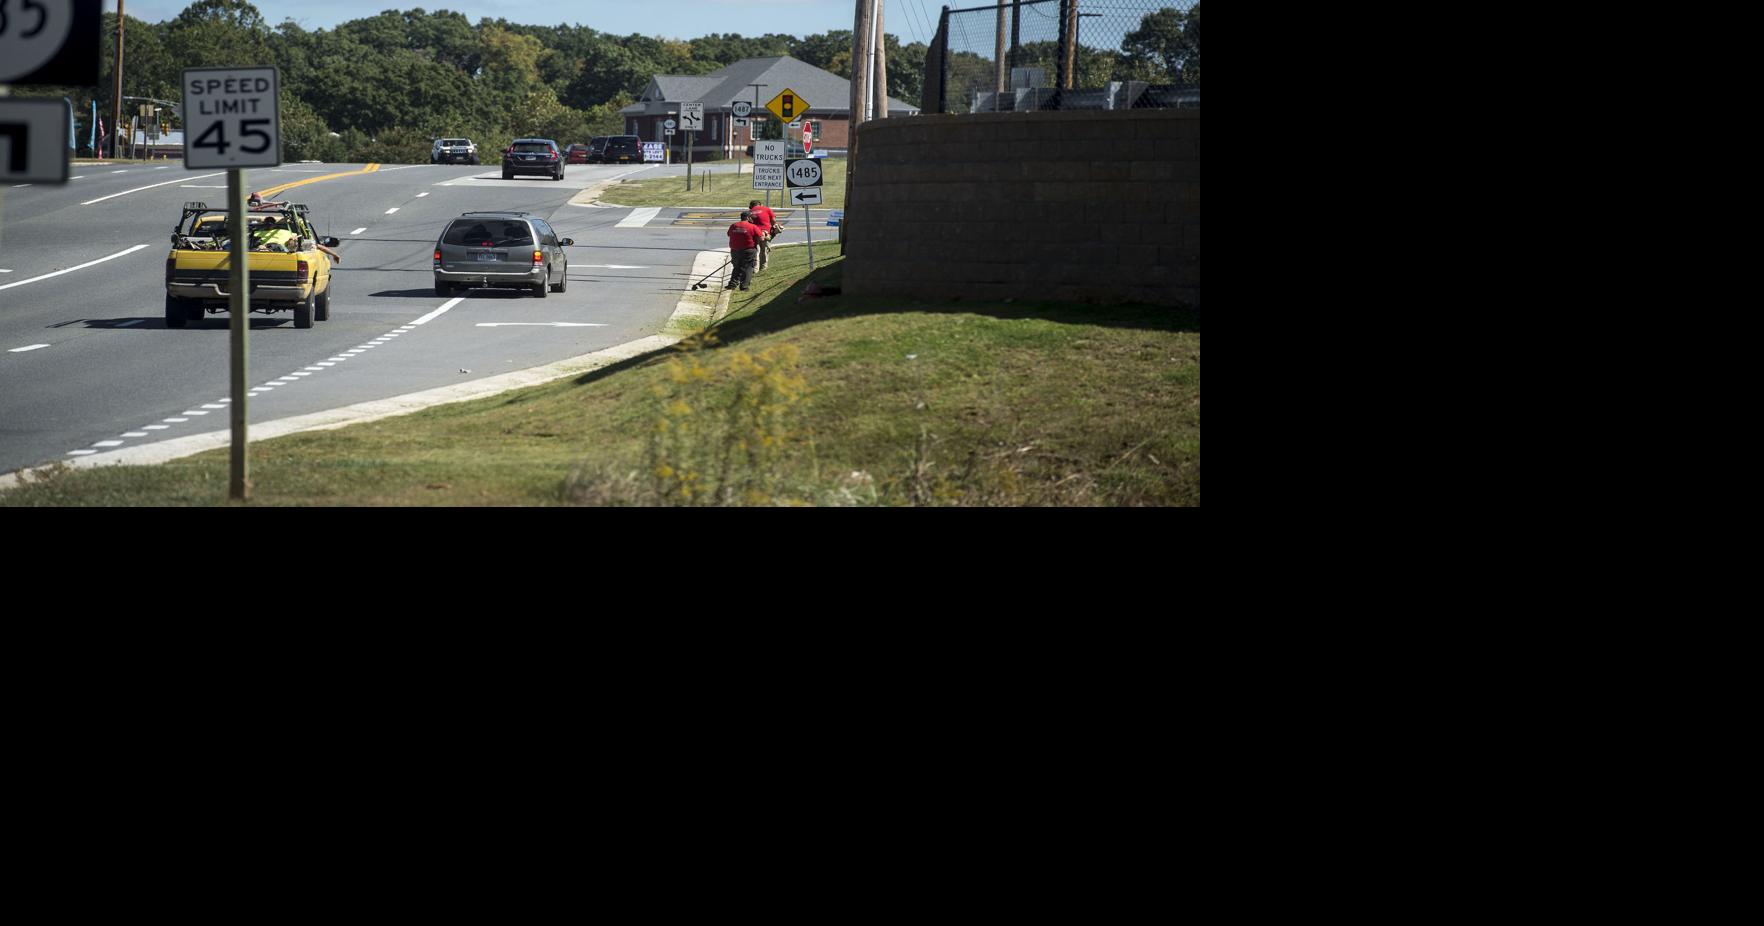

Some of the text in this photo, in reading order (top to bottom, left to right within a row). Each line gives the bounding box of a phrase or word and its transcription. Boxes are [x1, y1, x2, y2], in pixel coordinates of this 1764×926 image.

[190, 78, 270, 95] SPEED
[199, 98, 261, 116] LIMIT
[192, 118, 271, 154] 45
[791, 167, 818, 179] 1485
